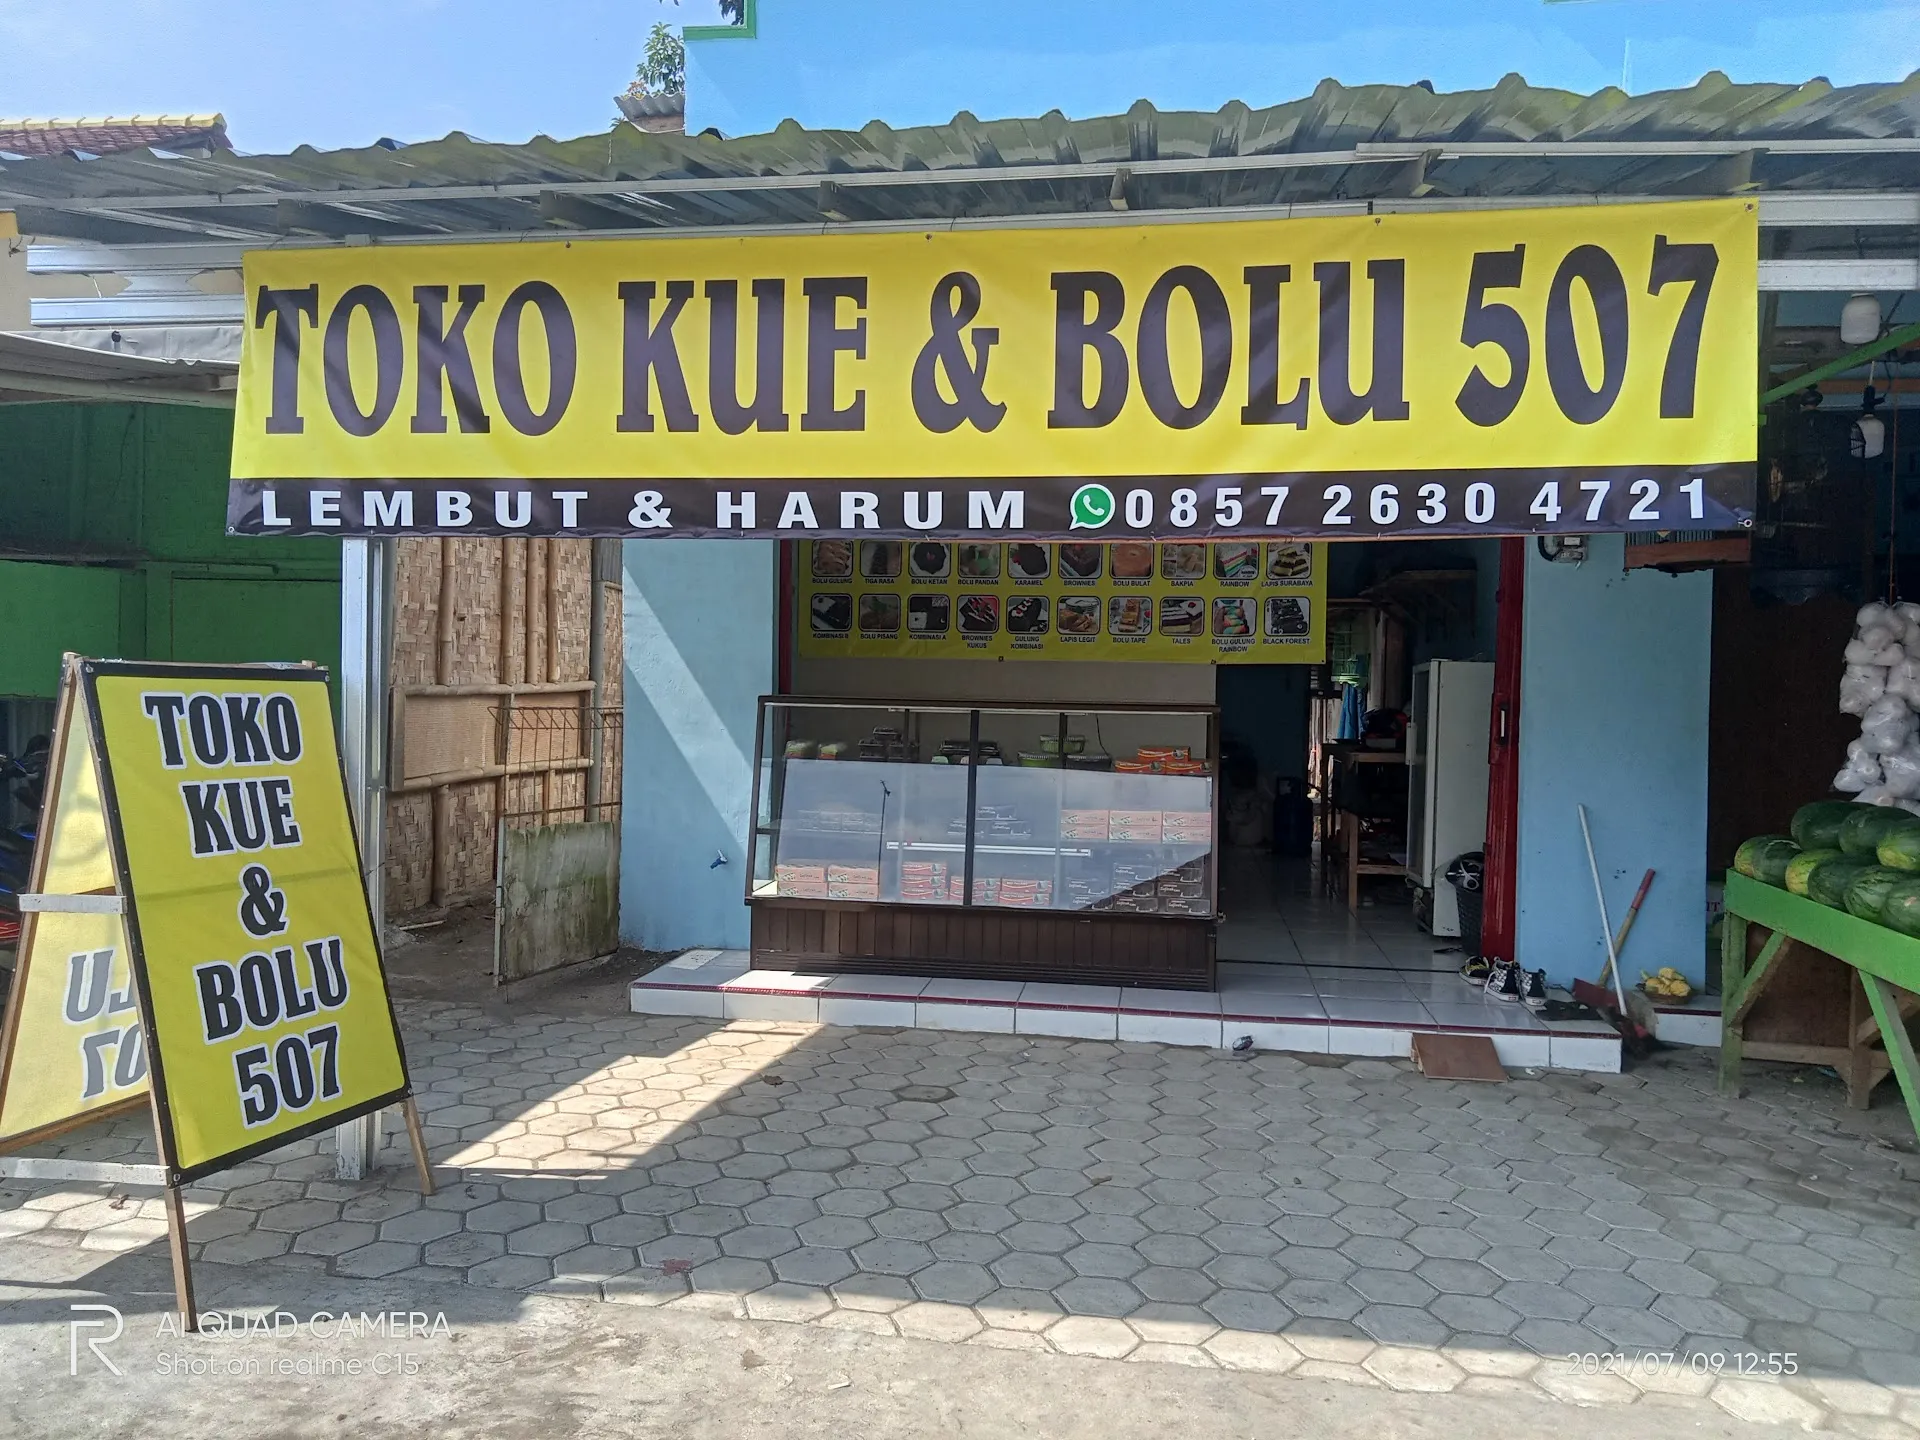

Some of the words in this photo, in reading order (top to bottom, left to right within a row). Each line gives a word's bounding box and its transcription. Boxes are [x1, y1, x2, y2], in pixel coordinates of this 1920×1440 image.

[254, 280, 577, 437] TOKO
[616, 275, 868, 436] KUE
[910, 271, 1007, 434] &
[1047, 257, 1410, 431] BOLU
[1455, 234, 1720, 428] 507
[262, 489, 589, 528] LEMBUT
[628, 489, 673, 529] &
[715, 489, 1025, 531] HARUM
[1124, 485, 1290, 530] 0857
[1322, 481, 1498, 526] 2630
[1530, 477, 1707, 523] 4721
[143, 692, 303, 769] TOKO
[180, 777, 303, 858] KUE
[239, 864, 290, 939] &
[193, 937, 350, 1045] BOLU
[231, 1023, 341, 1129] 507
